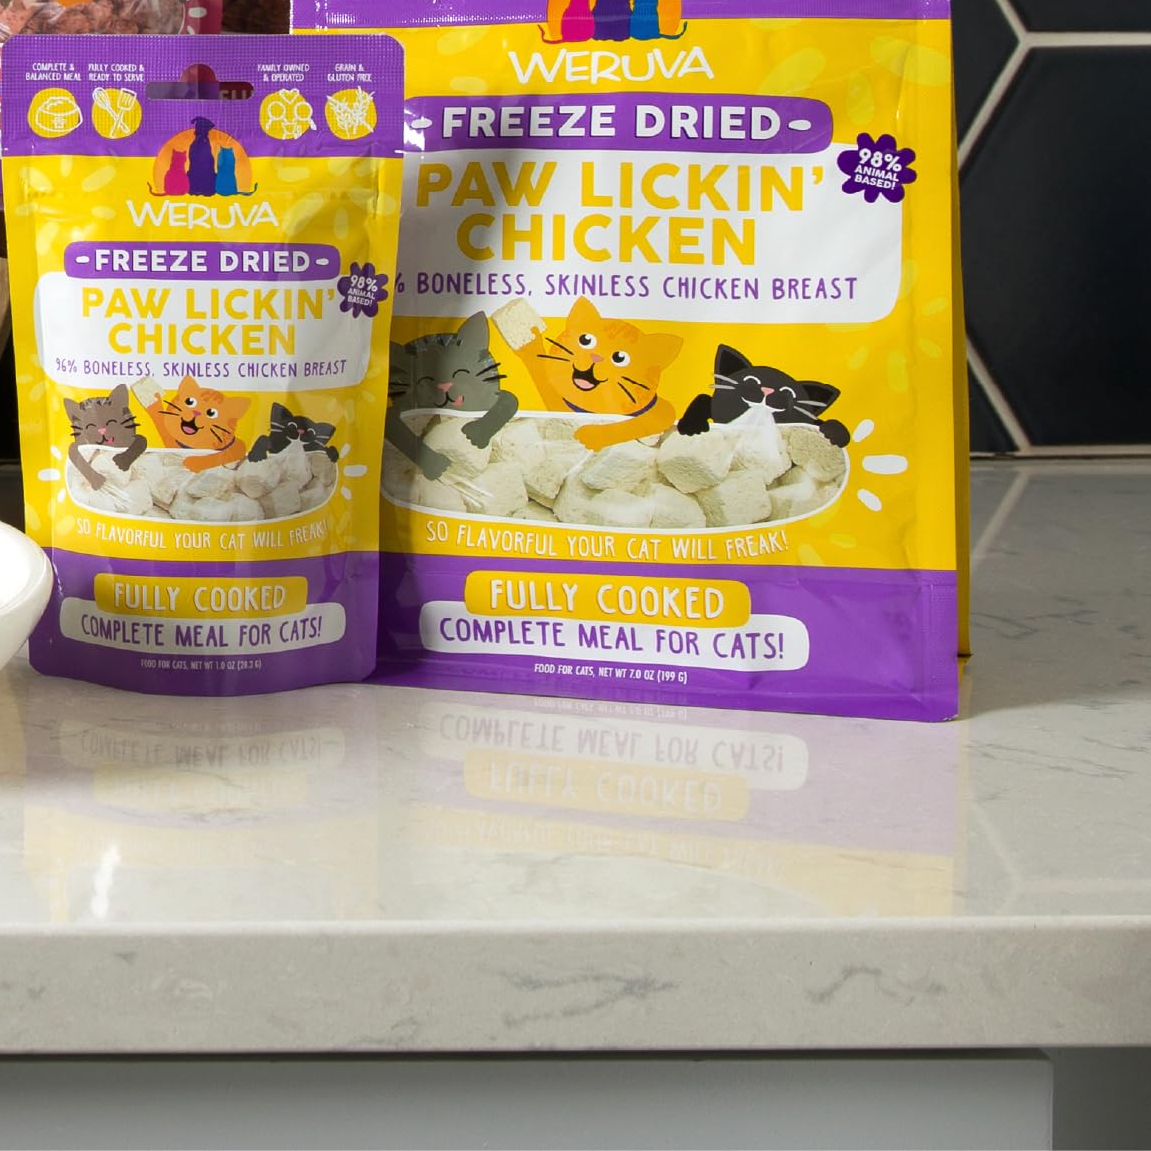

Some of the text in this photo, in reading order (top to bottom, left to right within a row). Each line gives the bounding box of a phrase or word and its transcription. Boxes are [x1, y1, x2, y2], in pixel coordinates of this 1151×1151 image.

[32, 63, 66, 71] COMPLETE
[88, 64, 108, 72] FULLY
[111, 64, 136, 72] COOKED
[258, 64, 310, 72] FAMILY OWNED
[335, 64, 356, 72] GRAIN
[508, 46, 714, 84] WERUVA
[26, 72, 82, 81] BALANCED MEAL
[89, 73, 109, 81] READY
[124, 74, 144, 82] SERVE
[271, 74, 304, 82] OPERATED
[328, 74, 372, 82] GLUTEN FREE
[859, 148, 902, 172] 98%
[854, 165, 899, 182] ANIMAL
[854, 174, 896, 190] BASED!
[416, 161, 557, 207] PAW
[126, 200, 279, 229] WERUVA
[456, 214, 755, 266] CHICKEN
[351, 275, 378, 292] 98%
[417, 272, 532, 296] BONELESS,
[546, 274, 650, 297] SKINLESS
[663, 277, 759, 299] CHICKEN
[772, 277, 857, 300] BREAST
[82, 287, 172, 319] PAW
[348, 288, 375, 300] ANIMAL
[348, 295, 373, 306] BASED!
[108, 322, 296, 355] CHICKEN
[55, 357, 347, 378] 96% BONELESS, SKINLESS CHICKEN BREAST
[76, 517, 328, 550] SO FLAVORFUL YOUR CAT WILL FREAK!
[426, 520, 789, 560] SO FLAVORFUL YOUR CAT WILL FREAK!
[114, 582, 286, 612] FULLY COOKED
[490, 579, 724, 619] FULLY COOKED
[81, 614, 323, 648] COMPLETE MEAL FOR CATS!
[440, 618, 784, 660] COMPLETE MEAL FOR CATS!
[192, 661, 202, 670] NET
[204, 661, 213, 670] WT
[534, 663, 555, 674] FOOD
[557, 665, 572, 675] FOR
[575, 666, 595, 678] CATS,
[599, 667, 613, 678] NET
[615, 668, 627, 678] WT
[630, 669, 641, 679] 7.0
[644, 670, 654, 680] OZ
[657, 670, 675, 683] (199
